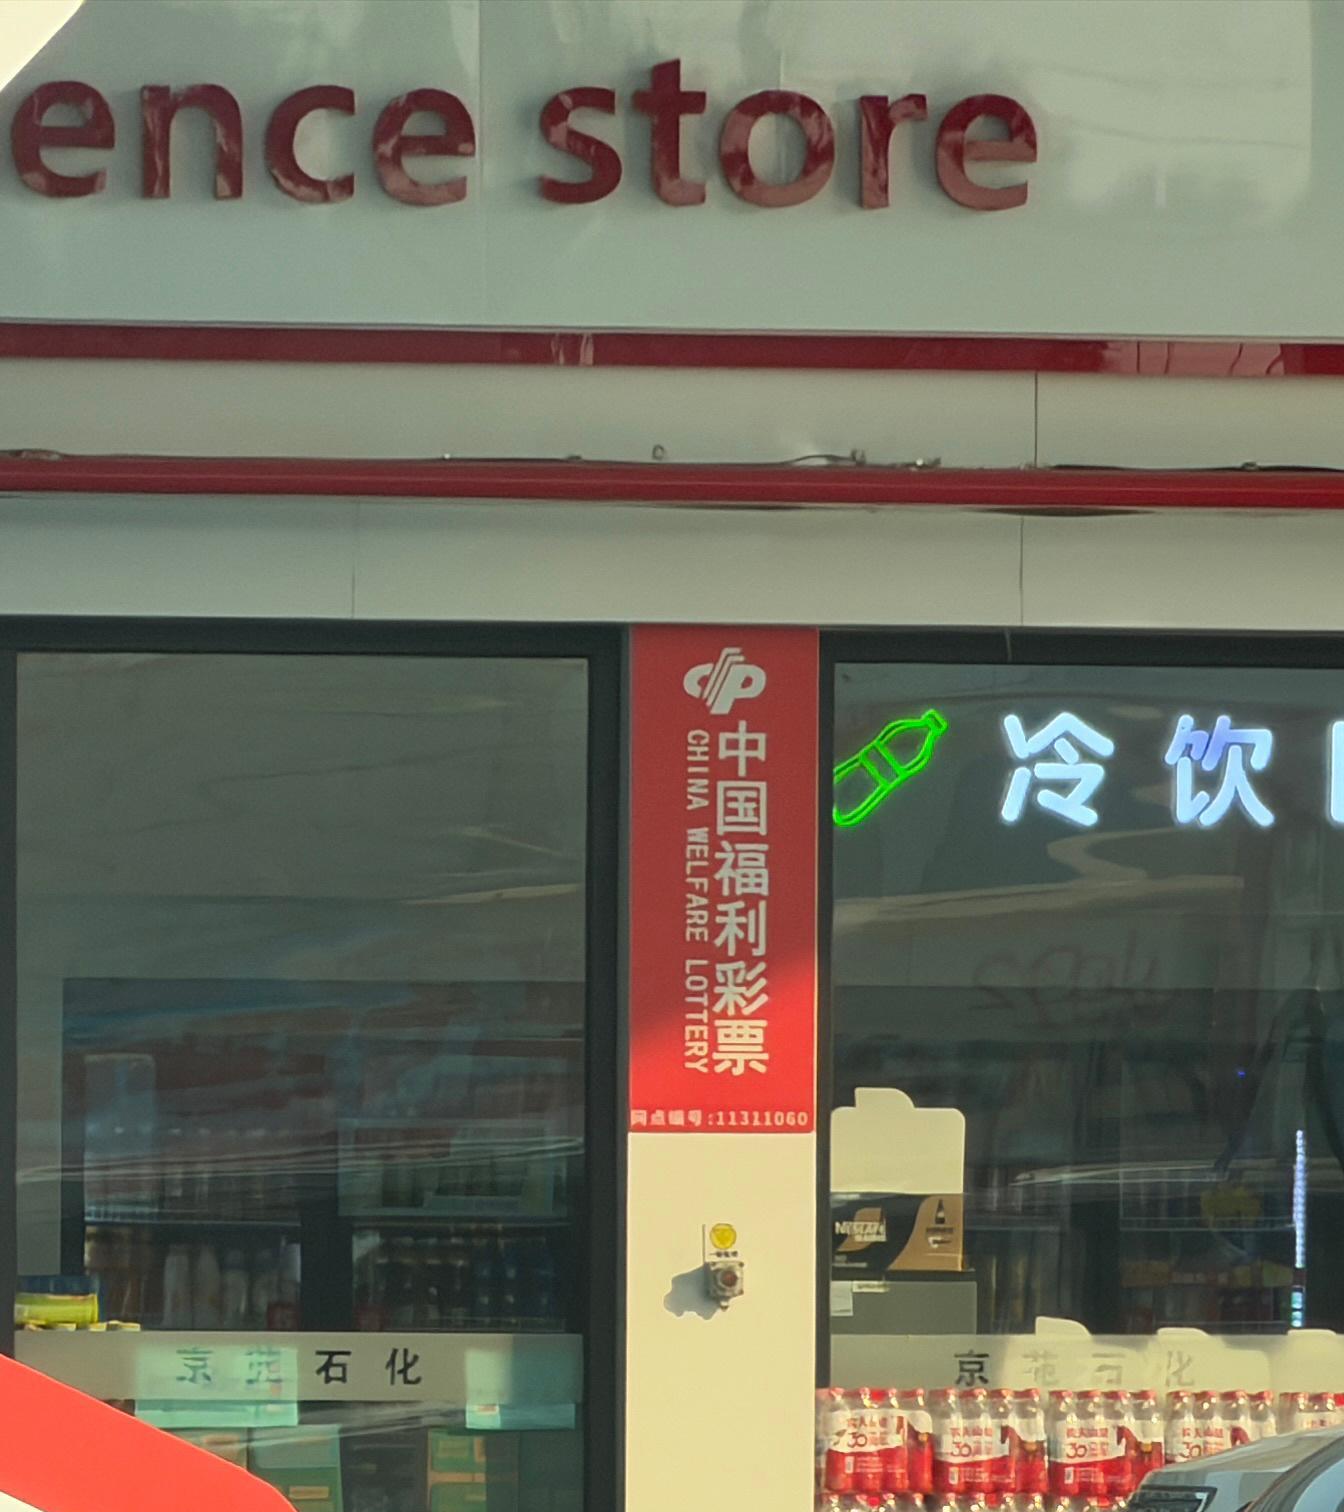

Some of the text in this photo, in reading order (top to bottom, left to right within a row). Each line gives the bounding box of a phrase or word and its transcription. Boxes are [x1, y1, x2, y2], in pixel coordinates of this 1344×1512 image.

[9, 57, 1040, 211] ence store
[684, 728, 710, 1074] CHINA WELFARE LOTTERY
[712, 719, 770, 1077] 中国福利彩票
[176, 1347, 422, 1385] 京苑石化
